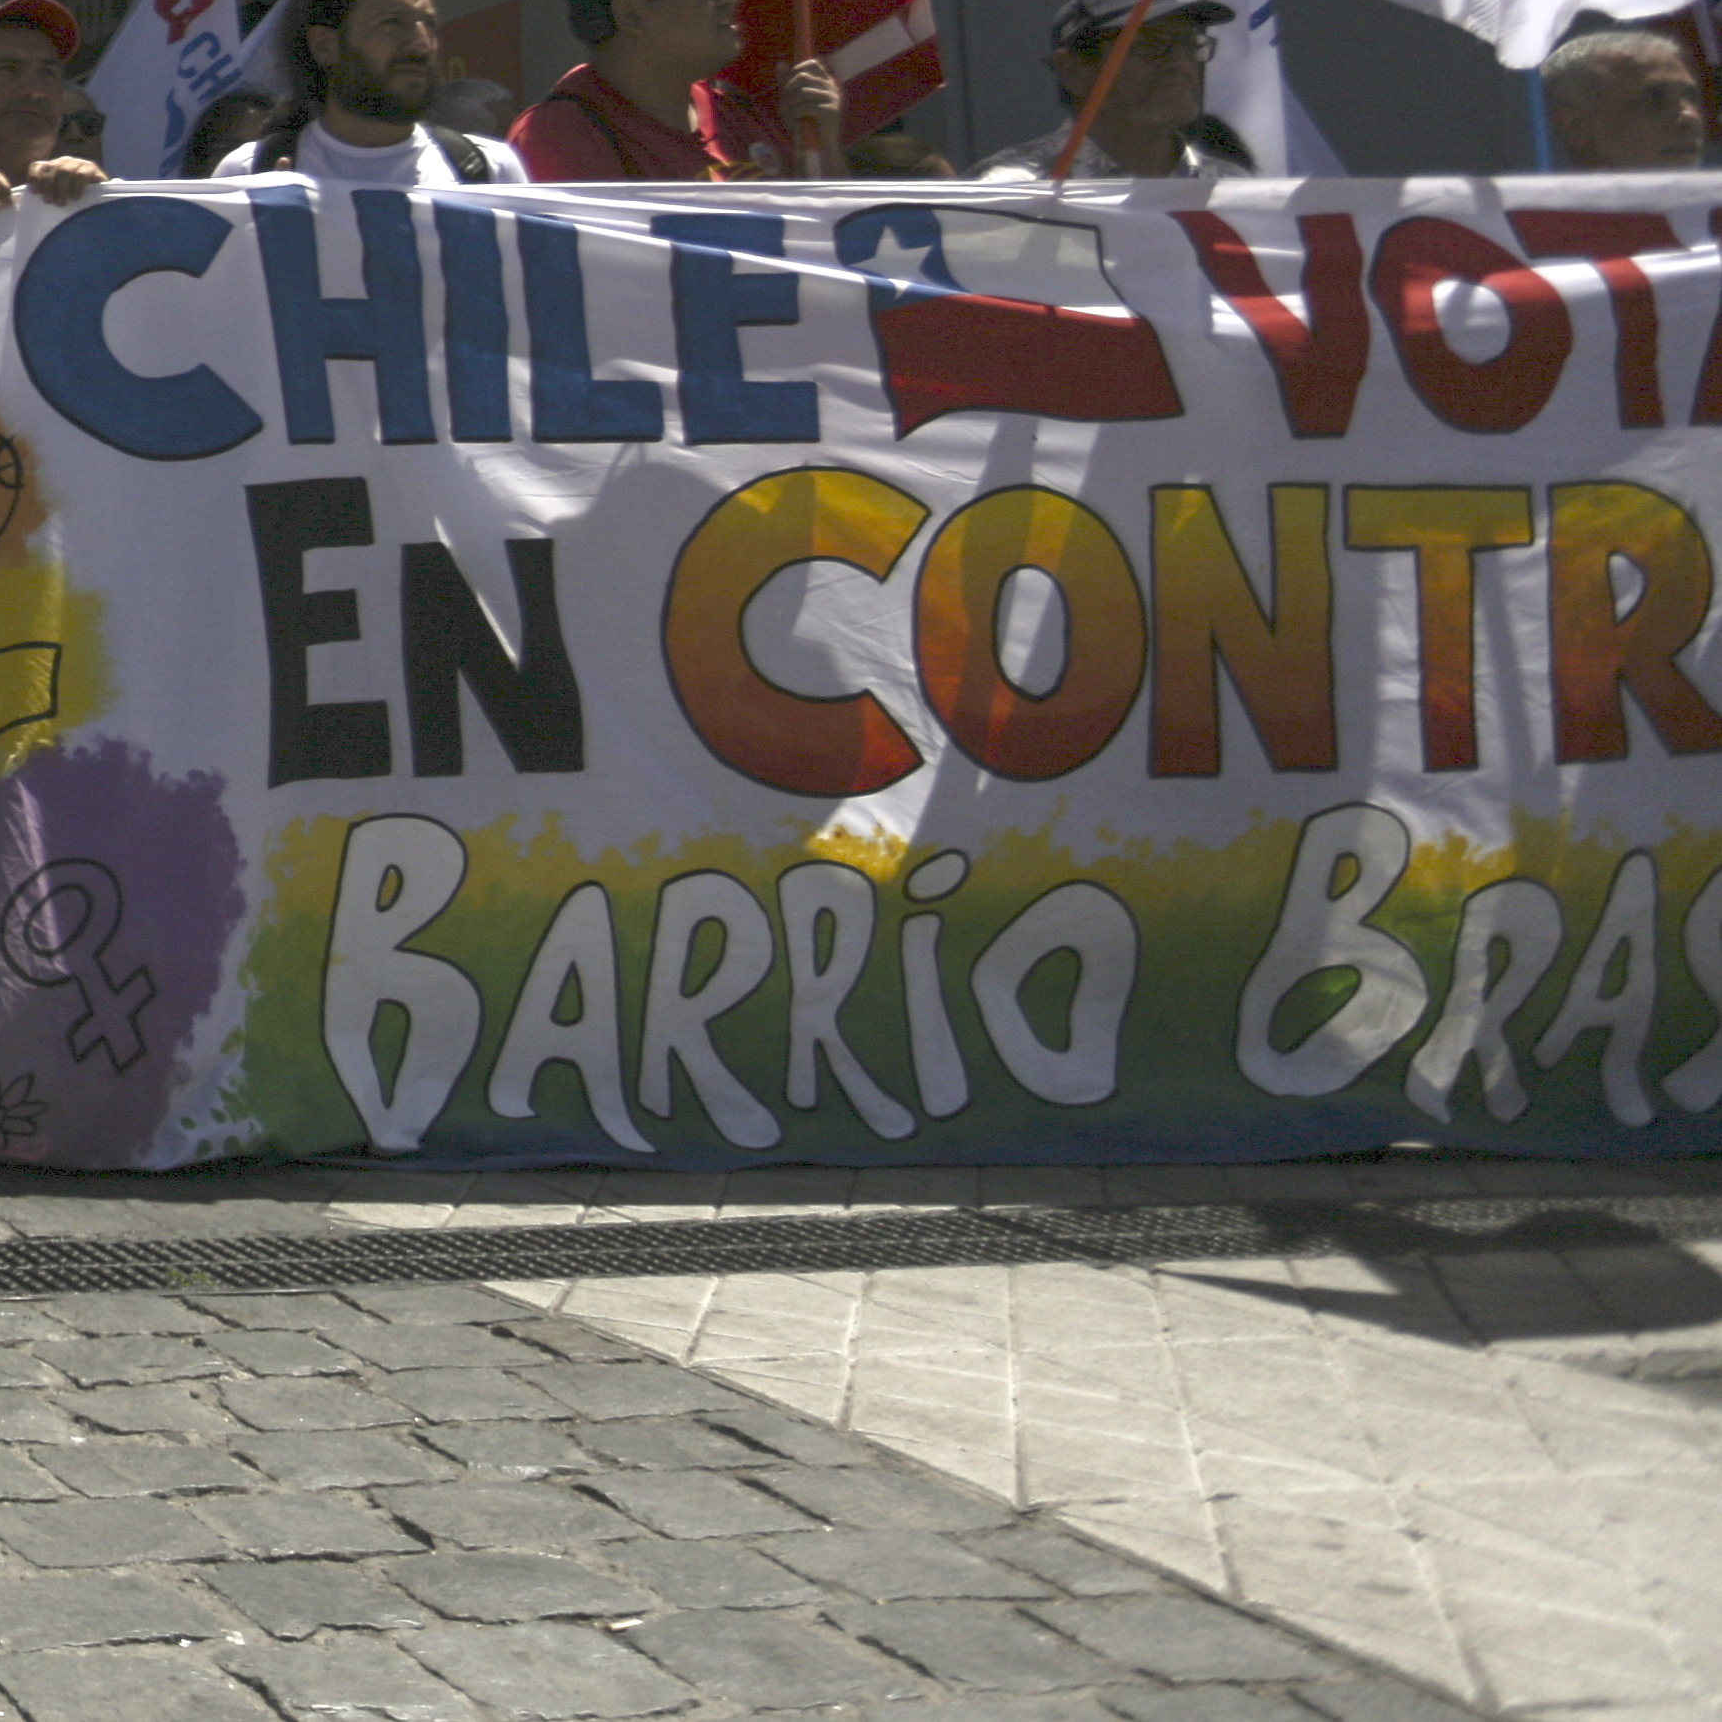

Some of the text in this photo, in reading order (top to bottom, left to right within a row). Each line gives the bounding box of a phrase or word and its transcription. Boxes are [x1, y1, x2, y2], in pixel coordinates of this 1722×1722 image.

[14, 185, 1722, 462] CHILE VOT
[245, 476, 585, 789] EN
